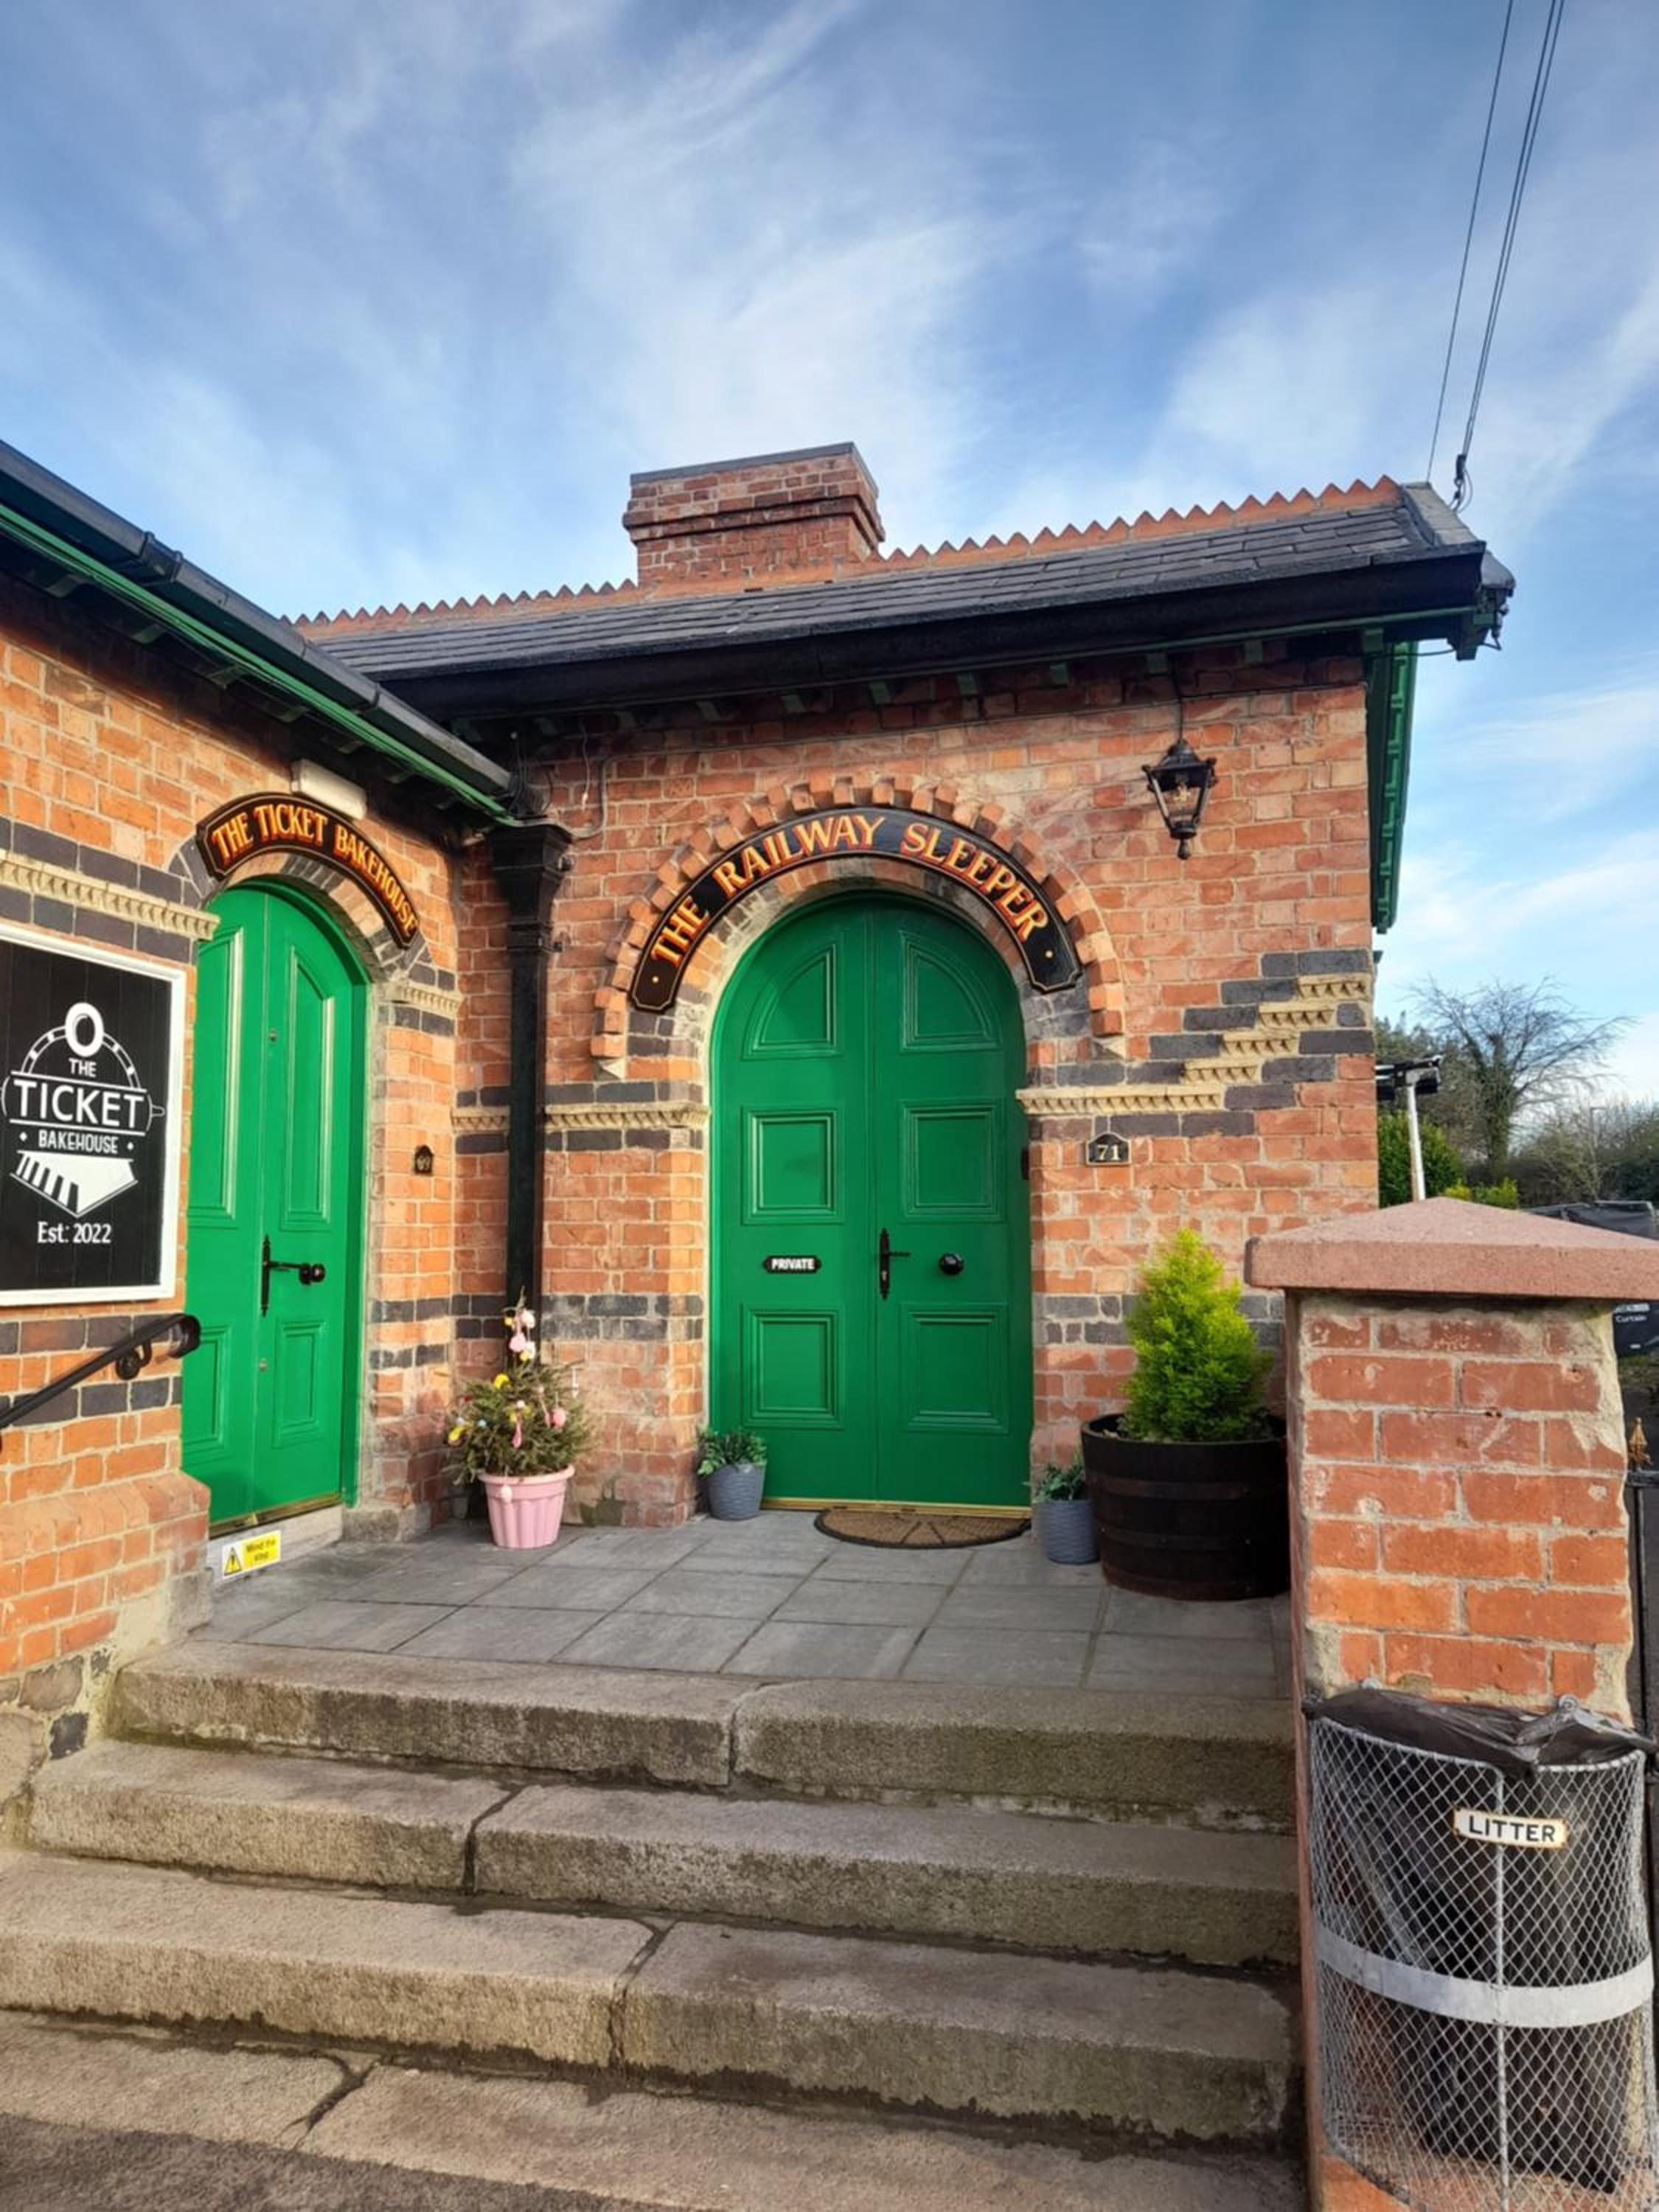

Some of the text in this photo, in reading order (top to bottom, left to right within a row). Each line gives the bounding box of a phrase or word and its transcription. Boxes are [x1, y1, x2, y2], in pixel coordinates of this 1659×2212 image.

[212, 803, 419, 937] THE TICKET BAKEHOUSE
[651, 815, 1048, 967] THE RAILWAY SLEEPER
[69, 1057, 97, 1078] THE
[13, 1079, 145, 1129] TICKET
[38, 1130, 119, 1154] BAKEHOUSE
[1096, 1144, 1121, 1161] 71
[73, 1222, 111, 1243] 2022
[771, 1257, 815, 1270] PRIVATE
[1470, 1815, 1556, 1842] LITTER
